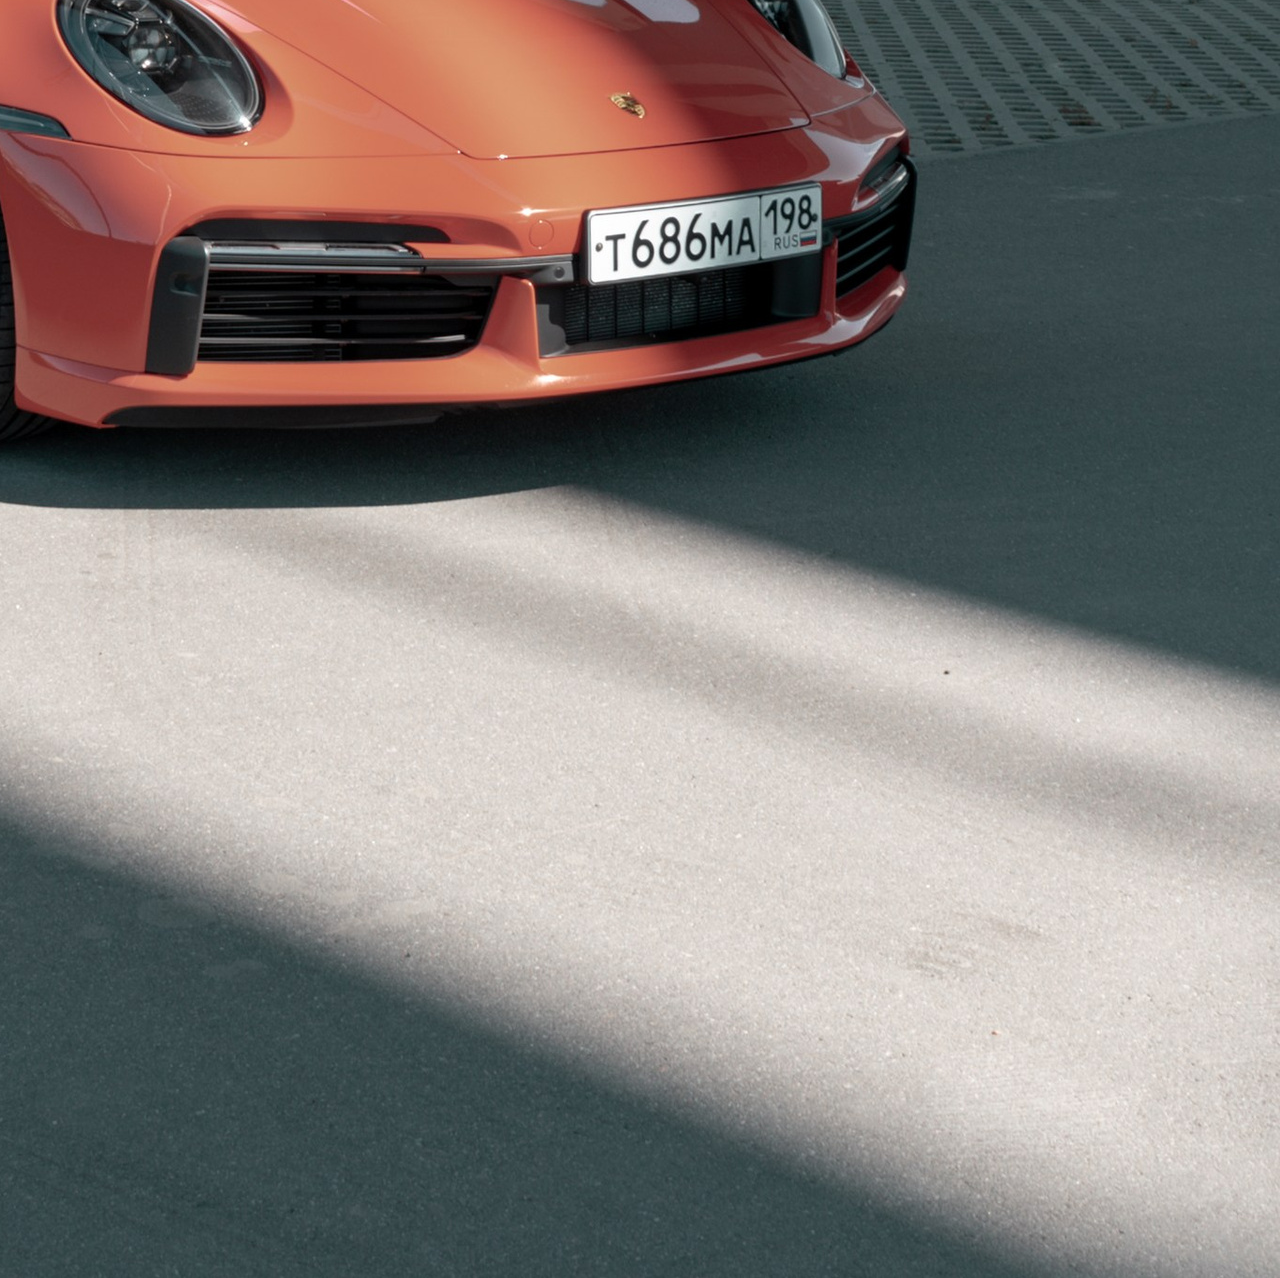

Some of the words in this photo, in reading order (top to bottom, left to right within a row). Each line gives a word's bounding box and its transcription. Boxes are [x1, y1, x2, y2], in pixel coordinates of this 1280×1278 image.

[605, 213, 756, 272] T686MA
[764, 194, 812, 235] 198
[774, 234, 799, 250] RUS
